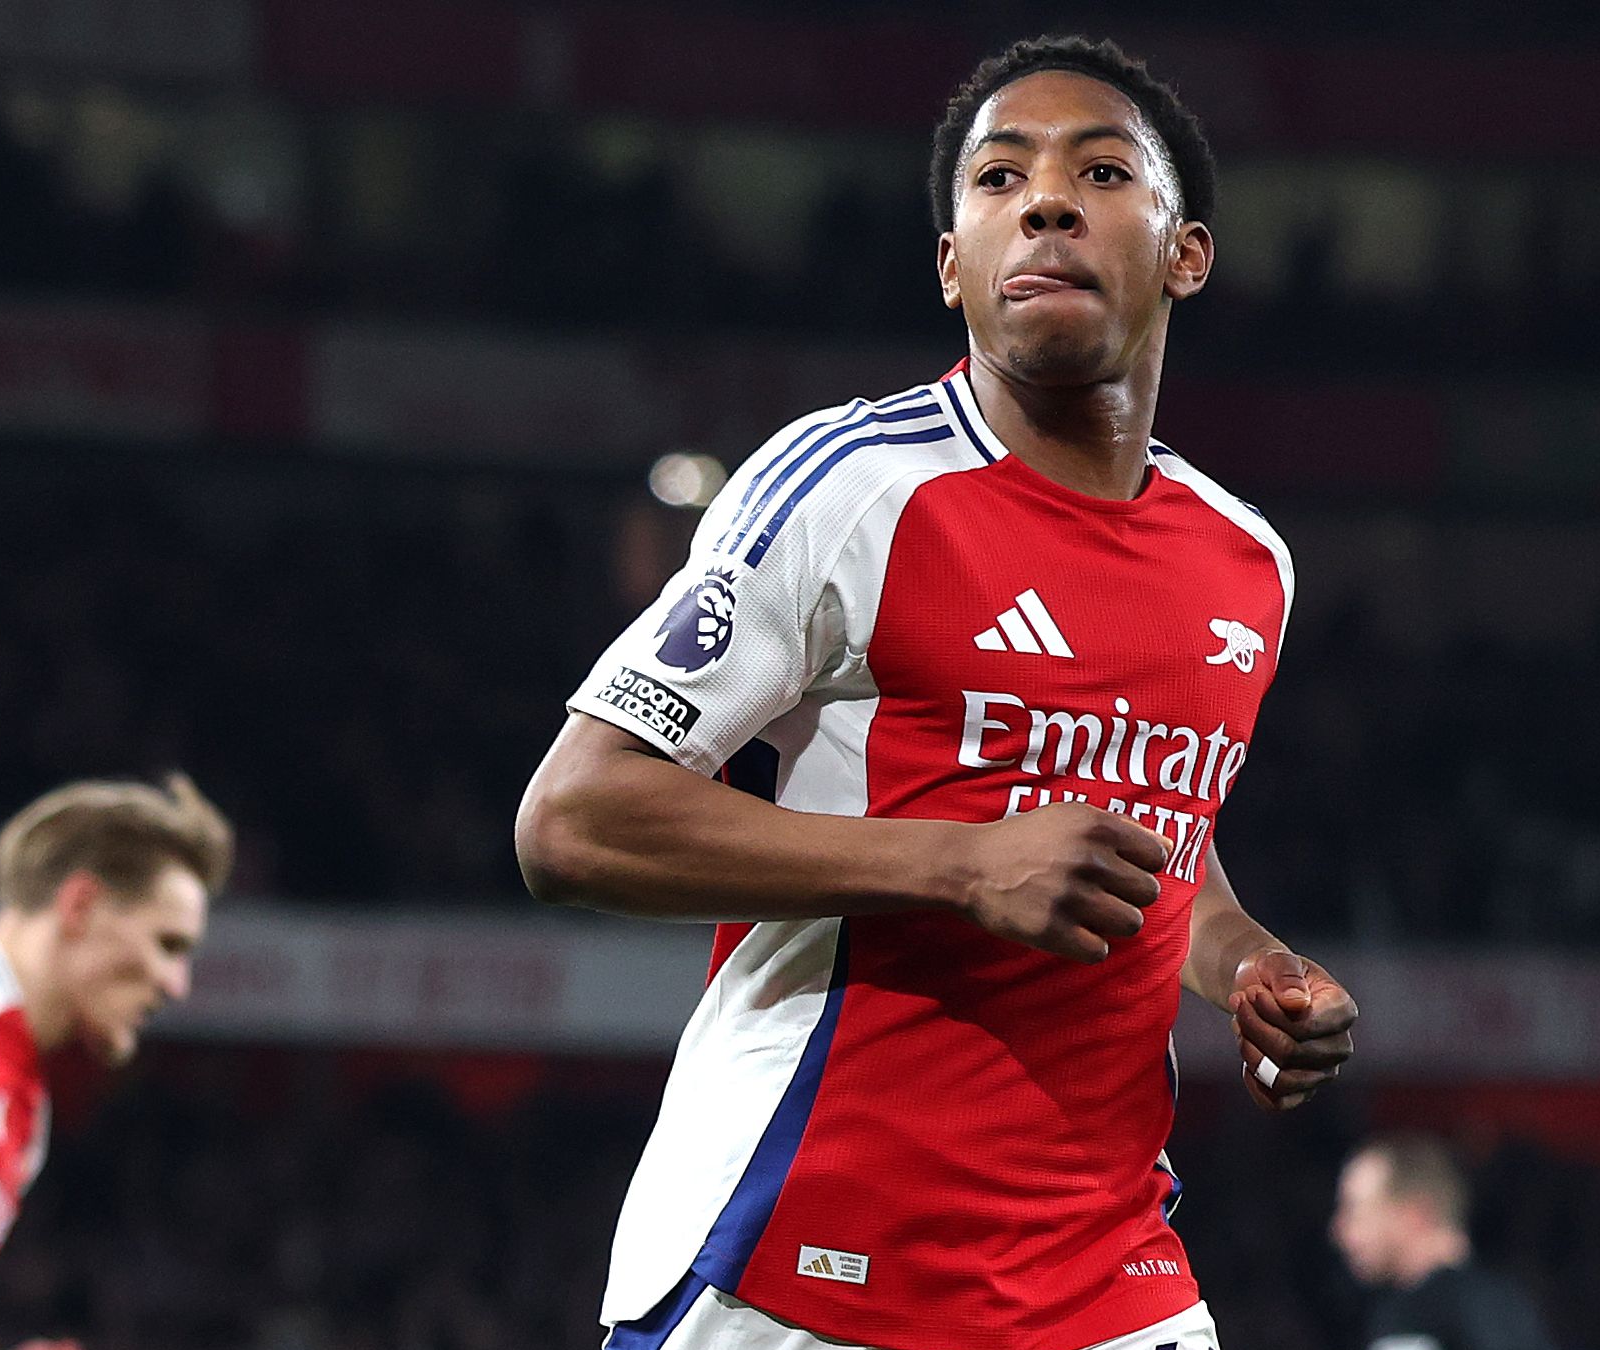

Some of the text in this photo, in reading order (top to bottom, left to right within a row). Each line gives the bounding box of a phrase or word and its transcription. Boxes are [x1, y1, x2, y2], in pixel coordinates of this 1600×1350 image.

[616, 692, 685, 746] racism
[630, 678, 688, 723] room
[958, 690, 1247, 804] Emirate
